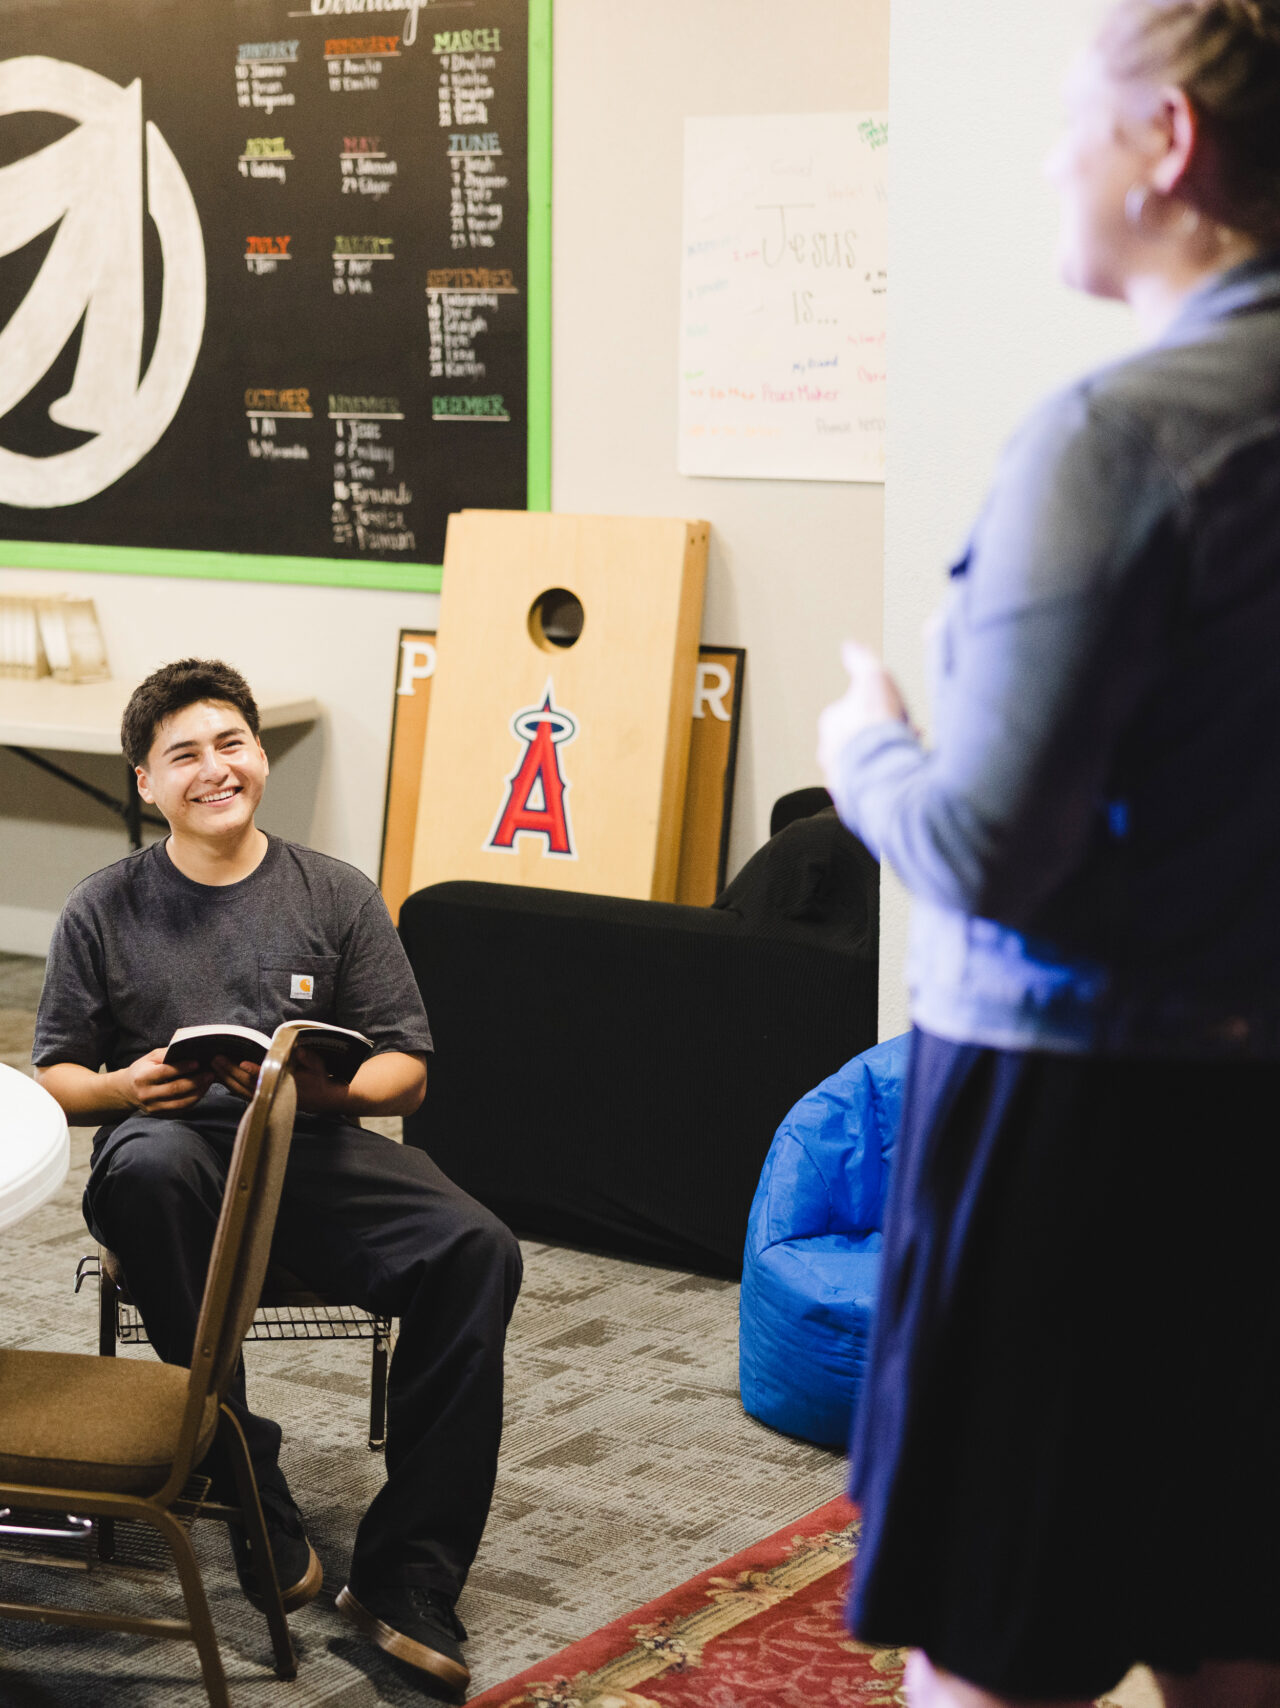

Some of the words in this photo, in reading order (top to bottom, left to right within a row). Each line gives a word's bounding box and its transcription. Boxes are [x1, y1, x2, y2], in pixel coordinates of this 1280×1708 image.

[432, 28, 500, 52] MARCH
[342, 136, 380, 153] MAY
[448, 133, 499, 150] JUNE
[246, 235, 291, 254] JULY
[754, 203, 857, 269] Jesus
[426, 267, 514, 288] SEPTEMBER
[244, 388, 312, 413] OCTOBER
[431, 394, 509, 416] DECEMBER
[397, 641, 437, 696] P
[693, 662, 732, 722] R
